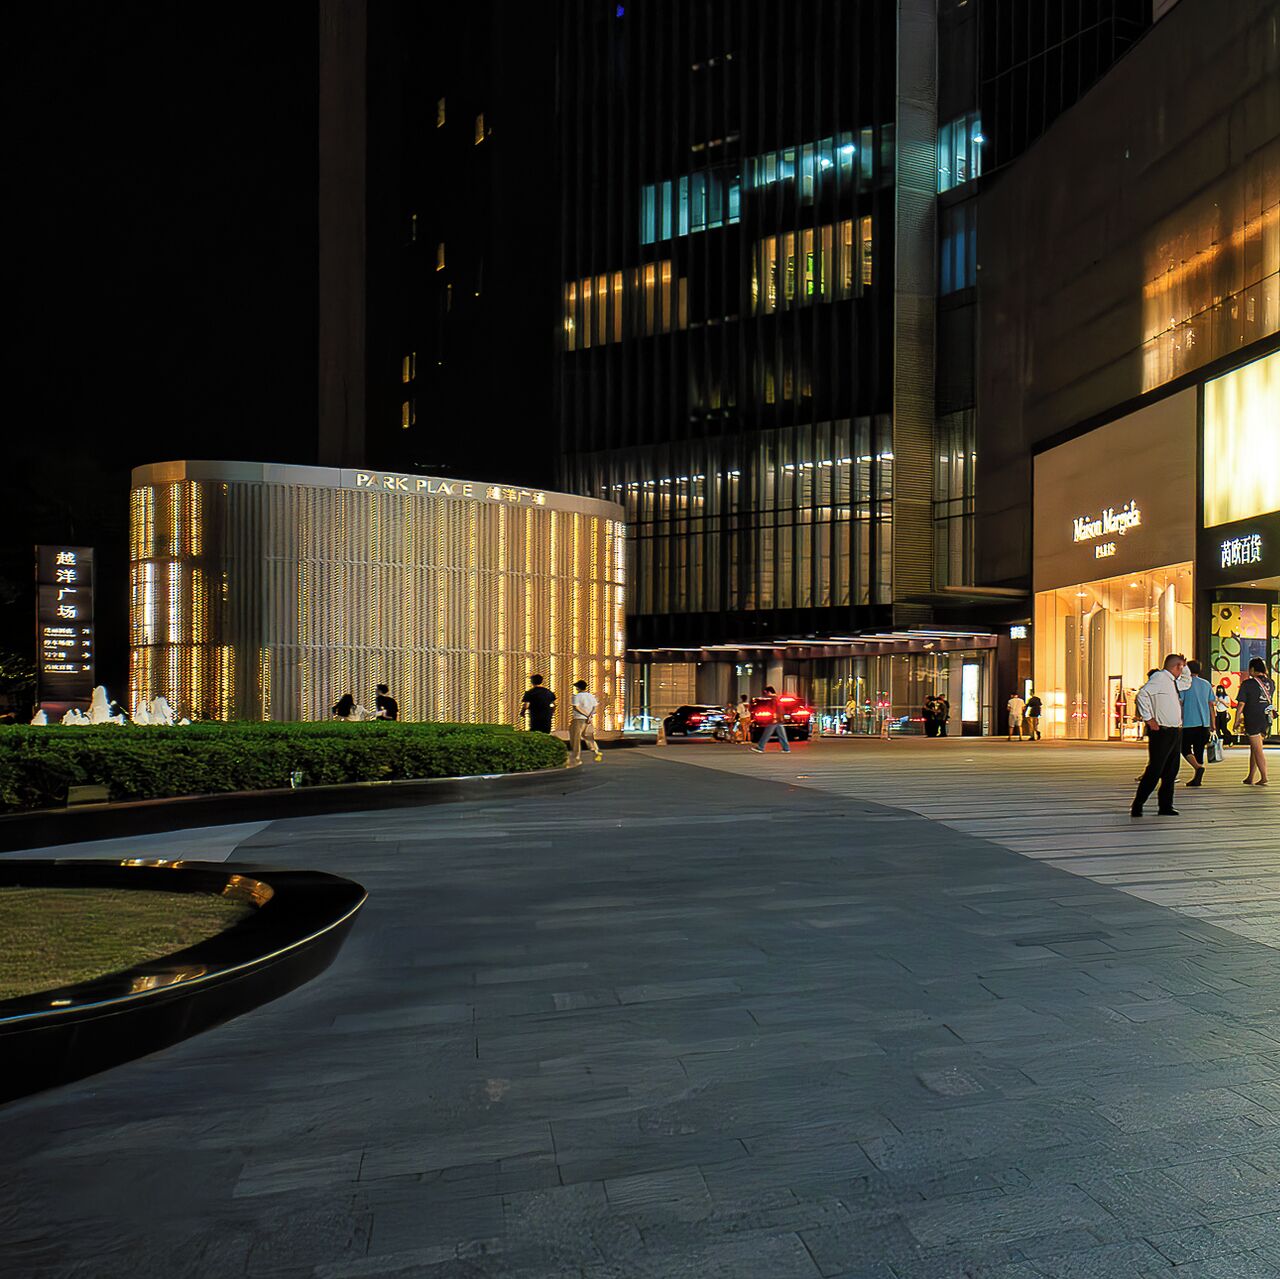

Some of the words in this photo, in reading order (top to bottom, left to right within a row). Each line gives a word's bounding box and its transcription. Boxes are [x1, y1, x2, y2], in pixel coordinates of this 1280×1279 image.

[356, 473, 409, 491] PARK
[416, 479, 473, 497] PLACE
[1073, 516, 1103, 543] Maison
[1220, 533, 1262, 569] 芮欧百货
[56, 551, 78, 619] 越洋广场
